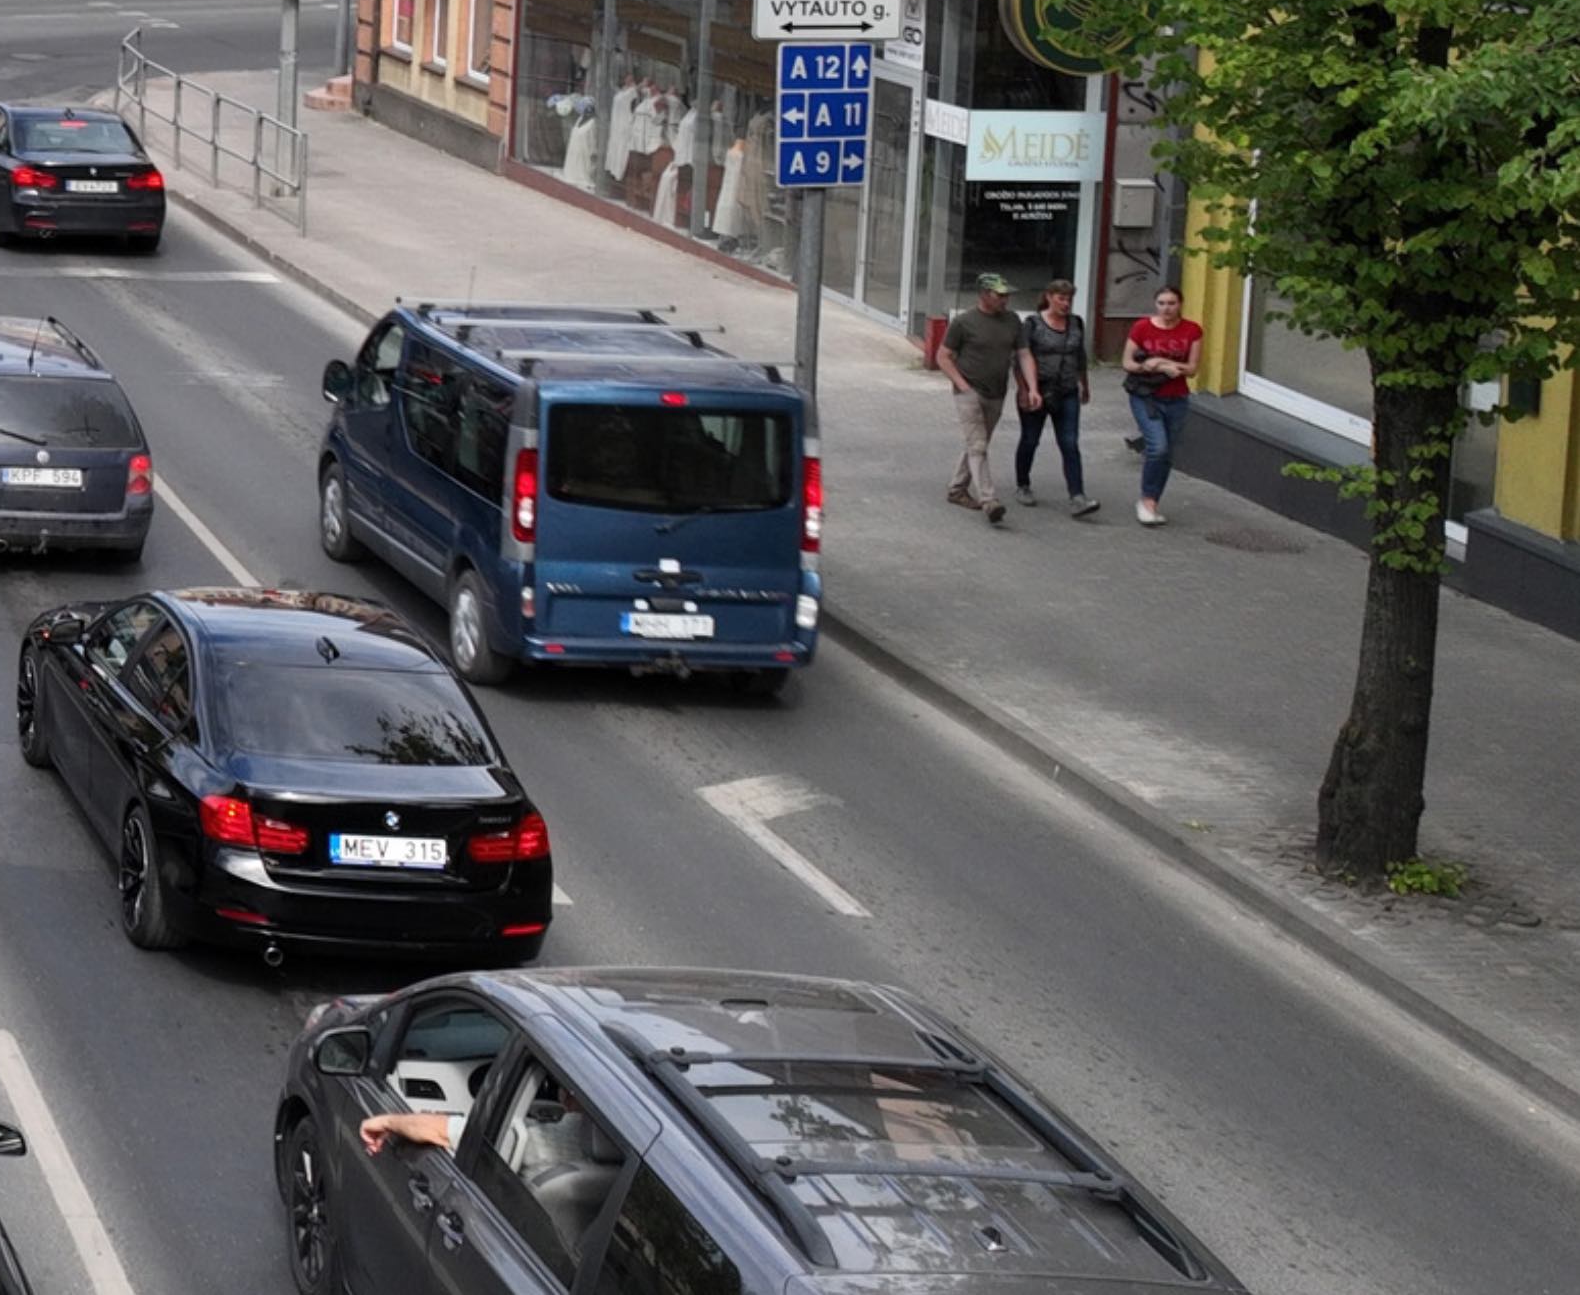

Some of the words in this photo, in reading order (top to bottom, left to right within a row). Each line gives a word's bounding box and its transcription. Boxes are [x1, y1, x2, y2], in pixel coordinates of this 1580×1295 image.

[770, 0, 867, 17] VYTAUTO
[873, 4, 891, 20] g.
[790, 56, 807, 79] A
[815, 56, 840, 79] 12
[814, 103, 831, 126] A
[843, 103, 861, 126] 11
[980, 124, 1089, 162] MEIDĖ
[790, 151, 806, 174] A
[815, 151, 830, 173] 9
[11, 468, 41, 482] KPF
[52, 470, 79, 484] 594
[344, 838, 390, 858] MEV
[405, 840, 443, 861] 315
